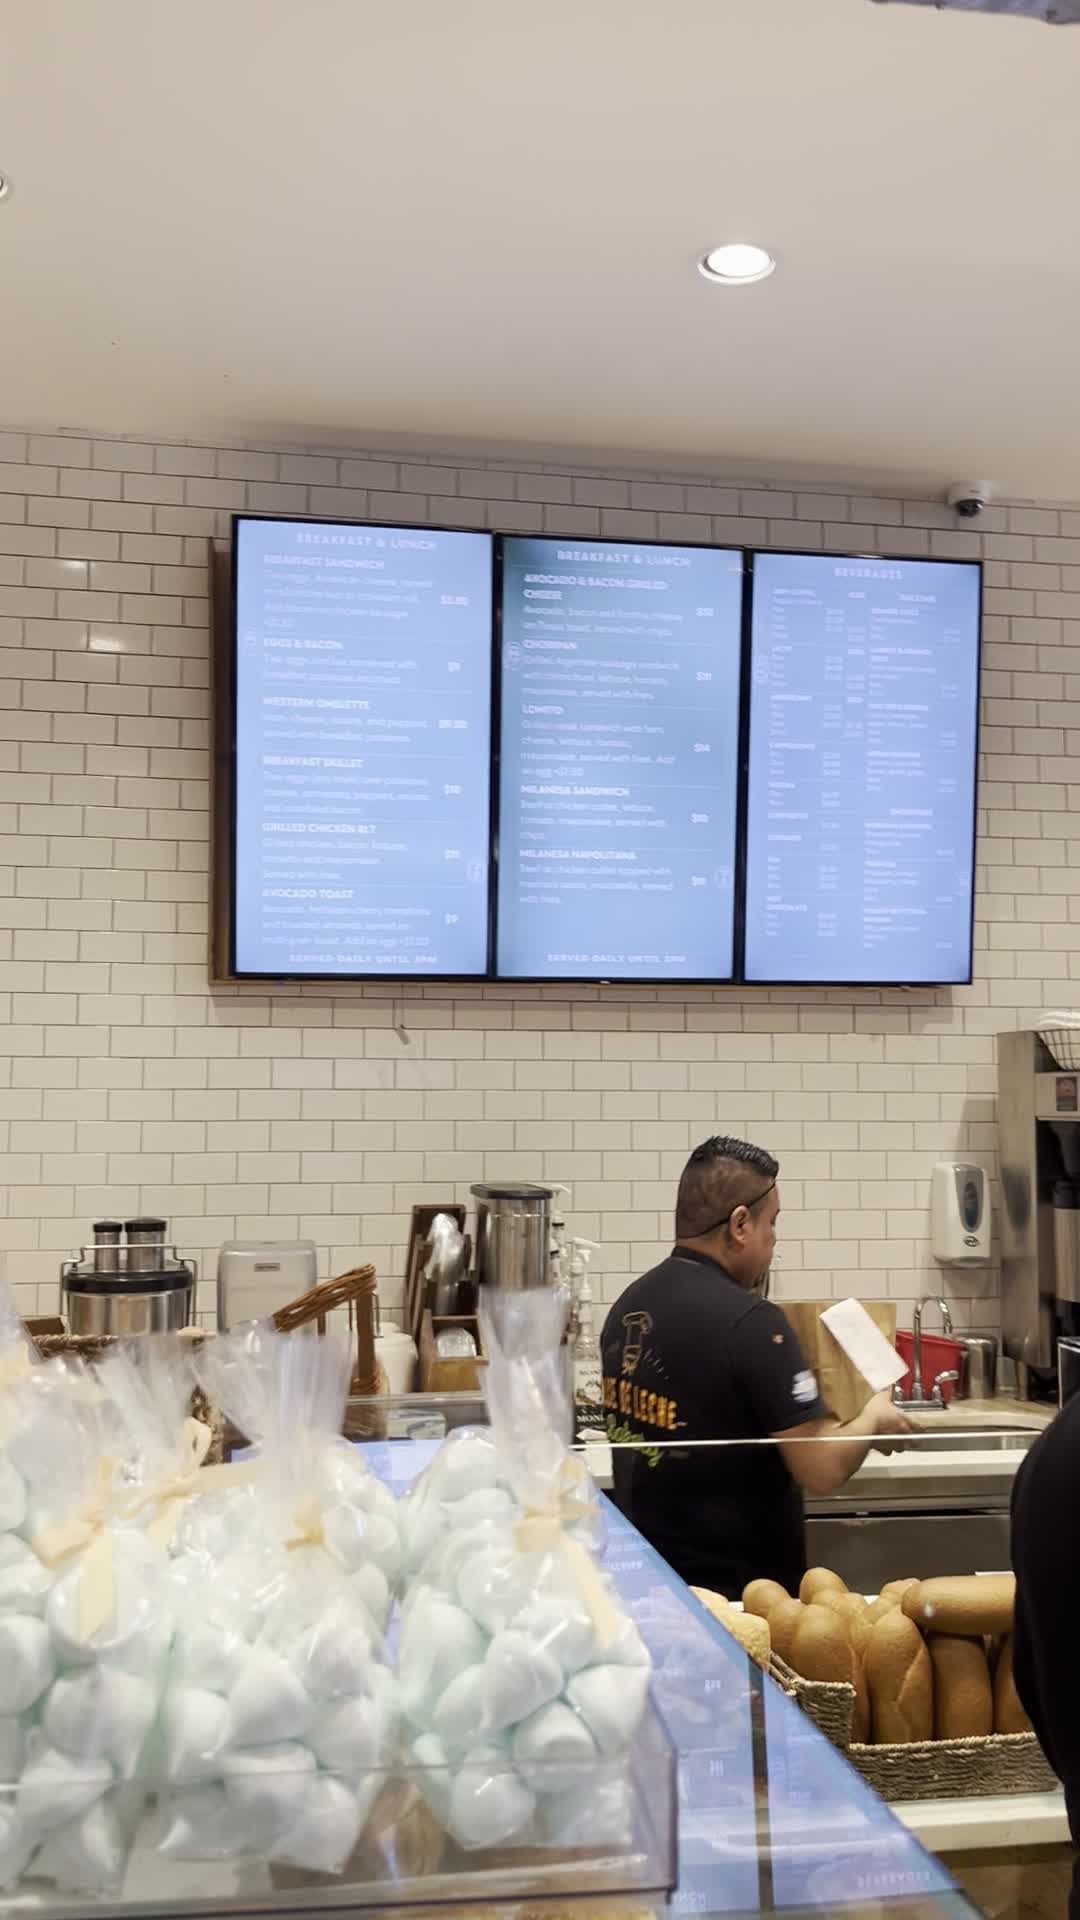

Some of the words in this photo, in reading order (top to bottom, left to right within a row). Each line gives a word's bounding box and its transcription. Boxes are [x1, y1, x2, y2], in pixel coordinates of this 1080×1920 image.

[296, 533, 371, 547] BREAKFAST
[375, 537, 385, 548] &
[557, 550, 630, 565] BREAKFAST
[633, 554, 642, 566] &
[648, 555, 691, 568] LUNCH
[524, 573, 576, 585] AVOCADO
[588, 576, 624, 588] BACON
[520, 784, 571, 796] MILANESA
[261, 822, 306, 833] GRILLED
[308, 824, 356, 834] CHICKEN
[519, 848, 570, 859] MILANESA
[261, 888, 318, 899] AVOCADO
[319, 889, 354, 899] TOAST
[288, 953, 335, 964] SERVED
[336, 954, 372, 964] DAILY
[375, 954, 411, 965] UNTIL
[547, 953, 591, 964] SERVED
[592, 953, 625, 964] DAILY
